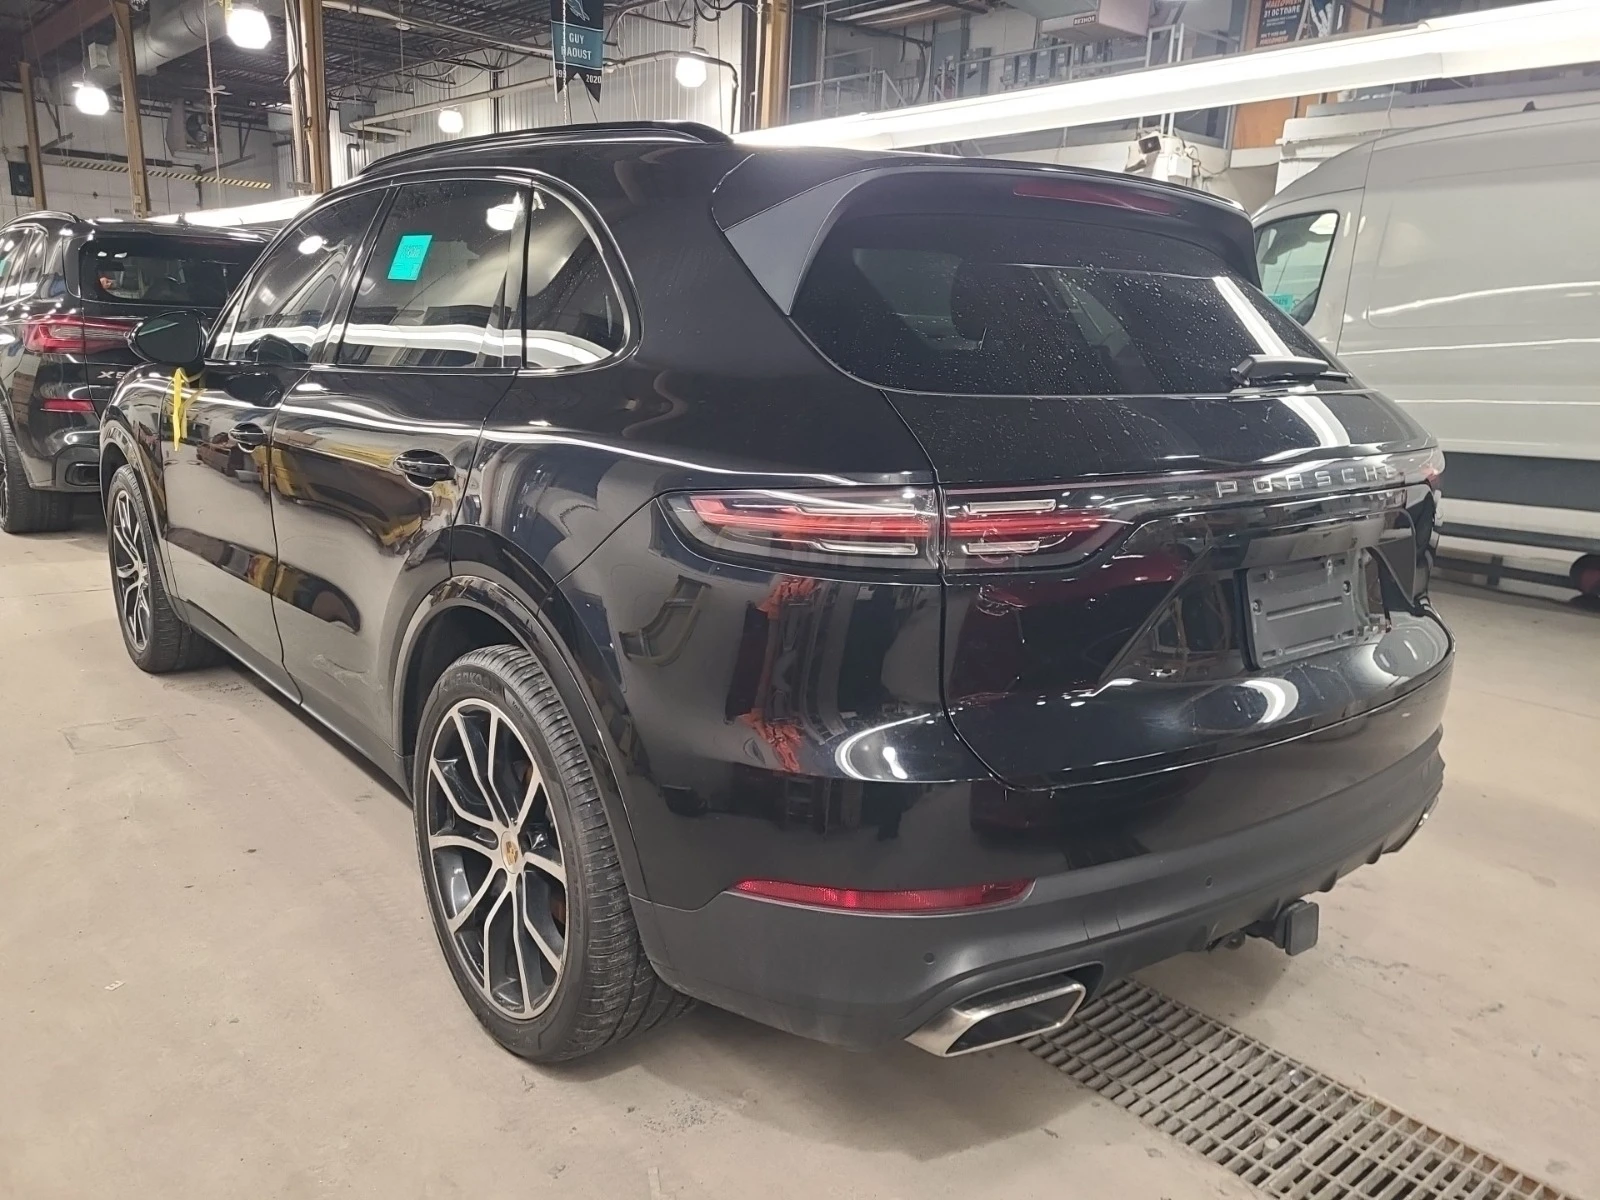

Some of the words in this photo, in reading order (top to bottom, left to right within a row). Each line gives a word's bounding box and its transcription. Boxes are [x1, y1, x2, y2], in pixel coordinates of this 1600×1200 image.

[569, 33, 584, 44] GUY
[586, 74, 602, 83] 2020
[1216, 466, 1397, 498] PORSCHE
